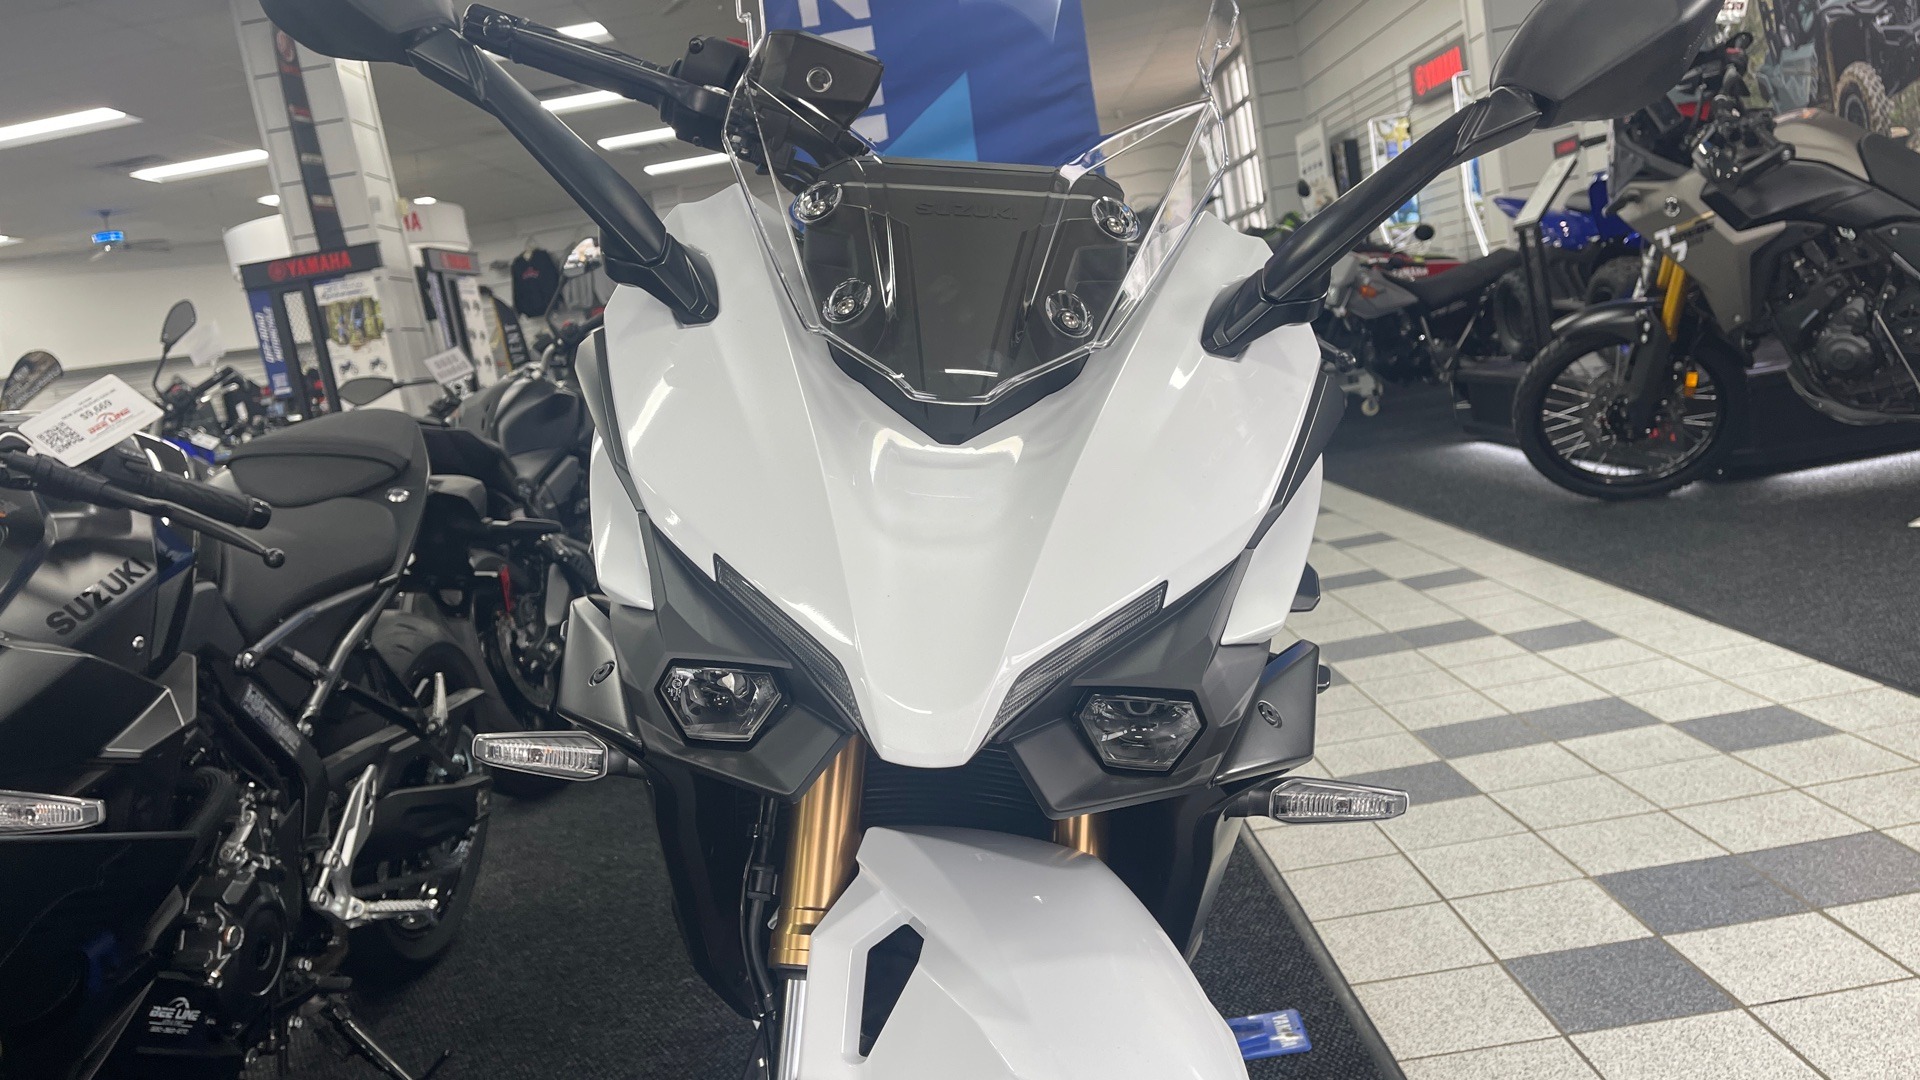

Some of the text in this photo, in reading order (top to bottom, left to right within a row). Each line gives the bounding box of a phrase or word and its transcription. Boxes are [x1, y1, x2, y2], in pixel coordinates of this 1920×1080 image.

[915, 202, 1018, 220] SUZUKI
[287, 251, 352, 278] YAMAHA
[46, 557, 151, 635] SUZUKI
